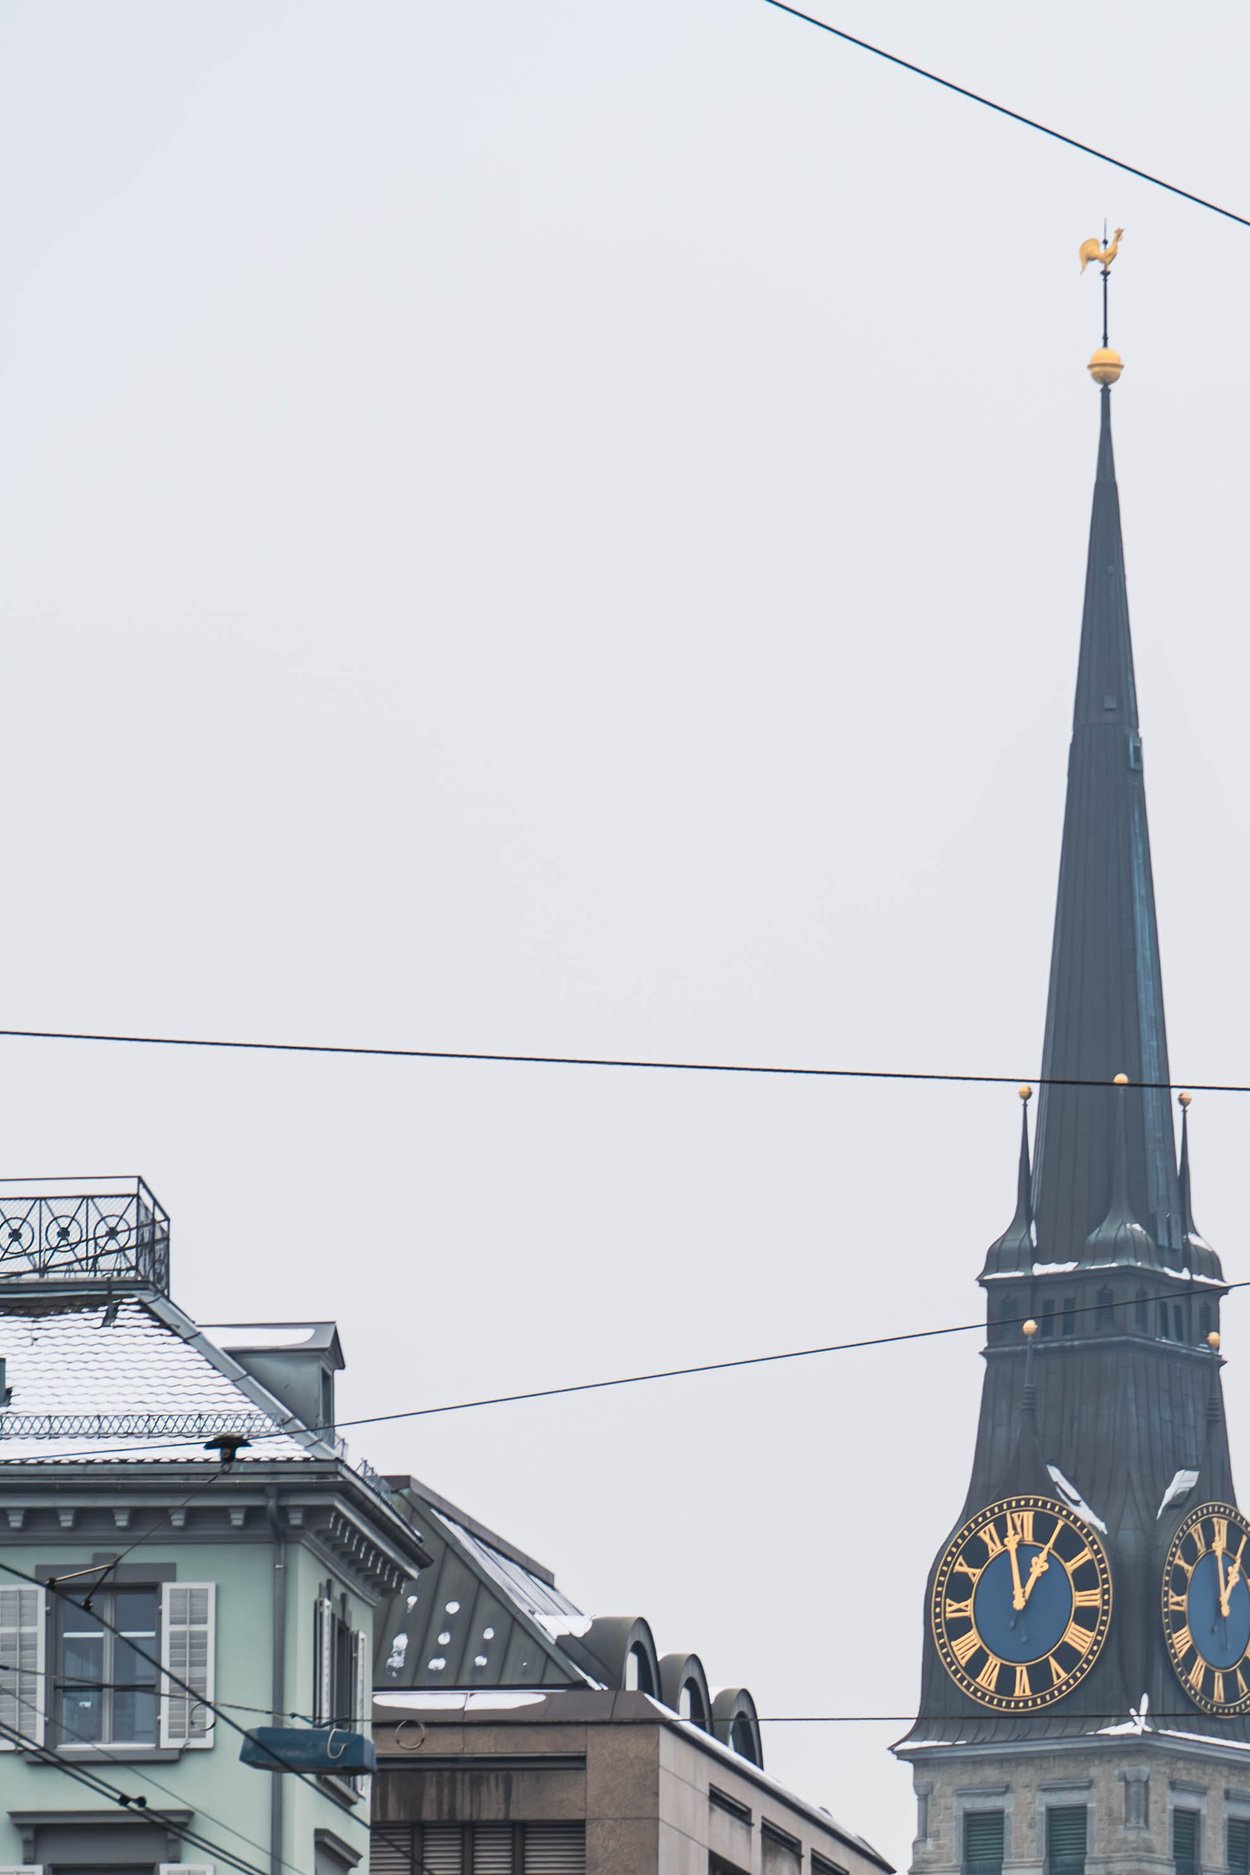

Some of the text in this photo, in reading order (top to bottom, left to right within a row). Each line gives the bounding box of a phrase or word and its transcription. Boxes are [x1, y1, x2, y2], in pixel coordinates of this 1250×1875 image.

[976, 1521, 1004, 1557] XI
[1190, 1523, 1207, 1557] XI
[953, 1555, 982, 1584] X
[1065, 1547, 1094, 1575] II
[1174, 1549, 1193, 1580] X
[945, 1598, 973, 1620] IX
[1074, 1587, 1101, 1608] III
[1168, 1591, 1186, 1611] IX
[950, 1628, 982, 1668] VIII
[975, 1655, 1001, 1692] VII
[1013, 1665, 1033, 1697] VI
[1048, 1655, 1069, 1686] V
